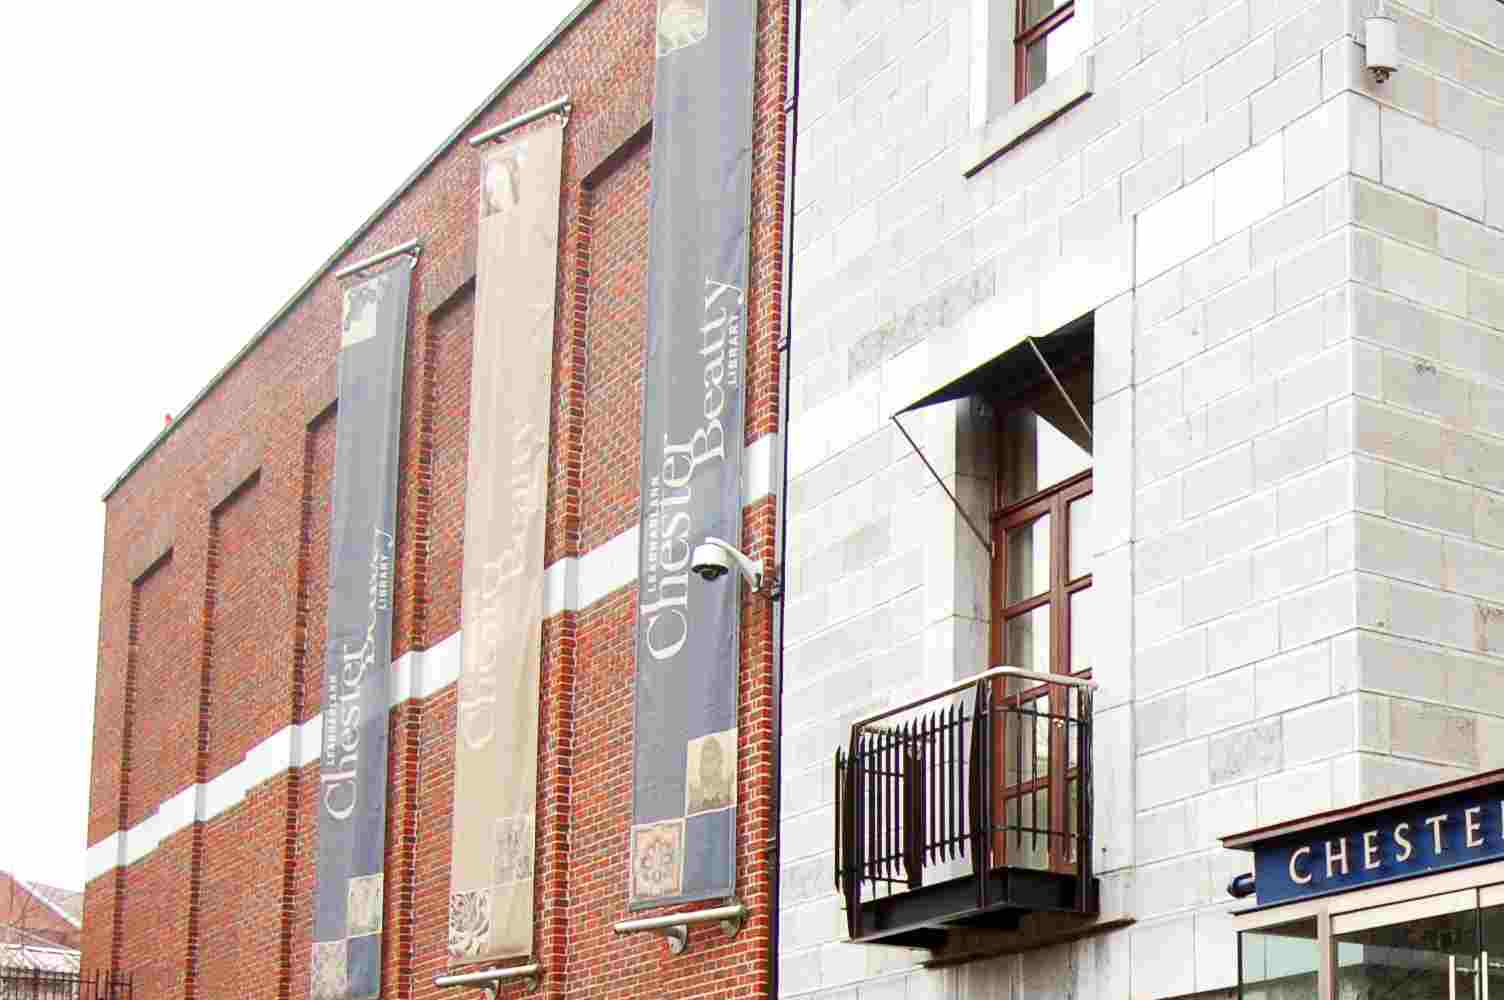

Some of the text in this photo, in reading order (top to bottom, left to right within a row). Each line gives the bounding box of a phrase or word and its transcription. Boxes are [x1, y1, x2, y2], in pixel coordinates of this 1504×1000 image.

[691, 274, 744, 470] Beatty
[726, 313, 740, 386] LIBRARY
[377, 553, 389, 612] LIBRARY
[639, 431, 692, 661] Chester
[320, 642, 363, 821] Chester
